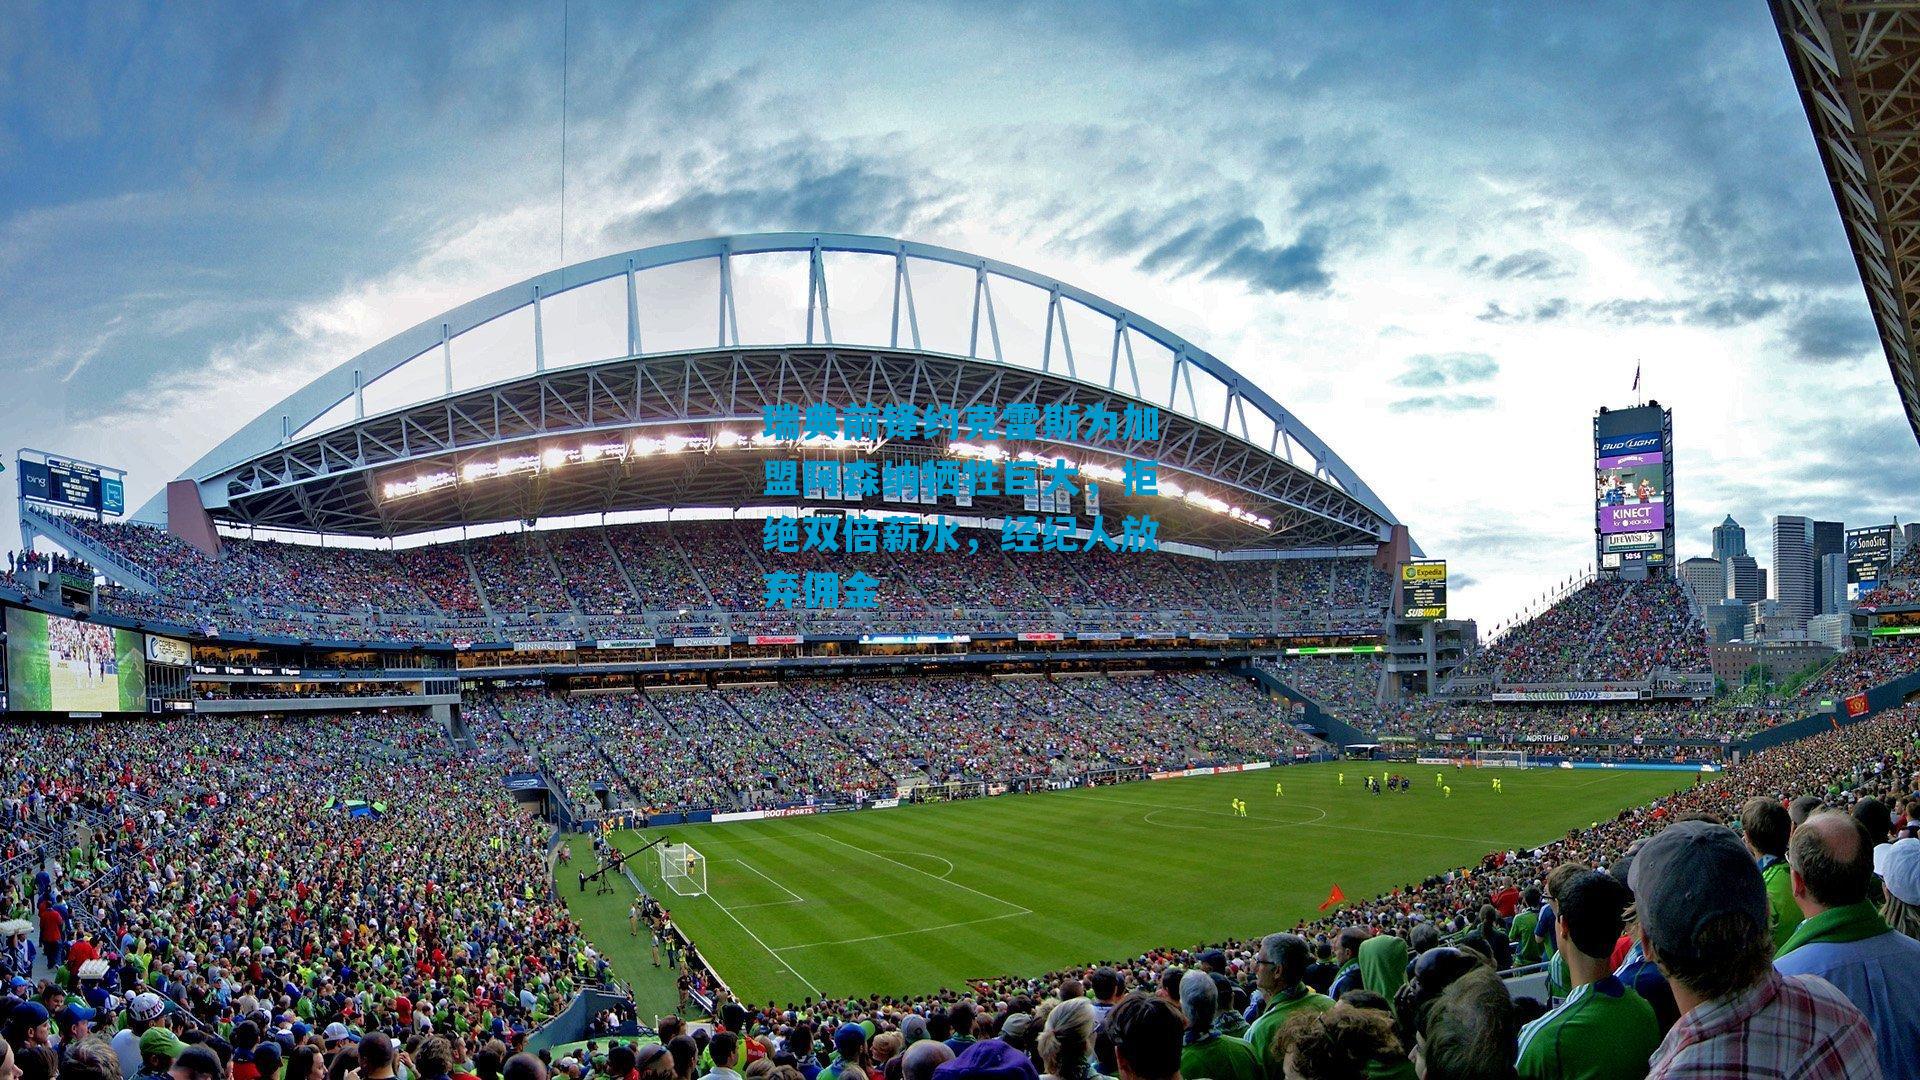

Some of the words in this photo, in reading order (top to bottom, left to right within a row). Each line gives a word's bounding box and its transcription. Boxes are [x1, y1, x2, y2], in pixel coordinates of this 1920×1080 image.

[1602, 442, 1624, 451] BUD
[26, 474, 46, 488] bing
[1613, 507, 1653, 520] KINECT
[1858, 535, 1886, 549] SonoSite
[1417, 568, 1442, 577] Expedia
[1405, 607, 1445, 618] SUBWAY
[1526, 734, 1552, 742] NORTH
[1553, 734, 1569, 742] END
[765, 808, 786, 818] ROOT
[786, 807, 814, 816] SPORTS
